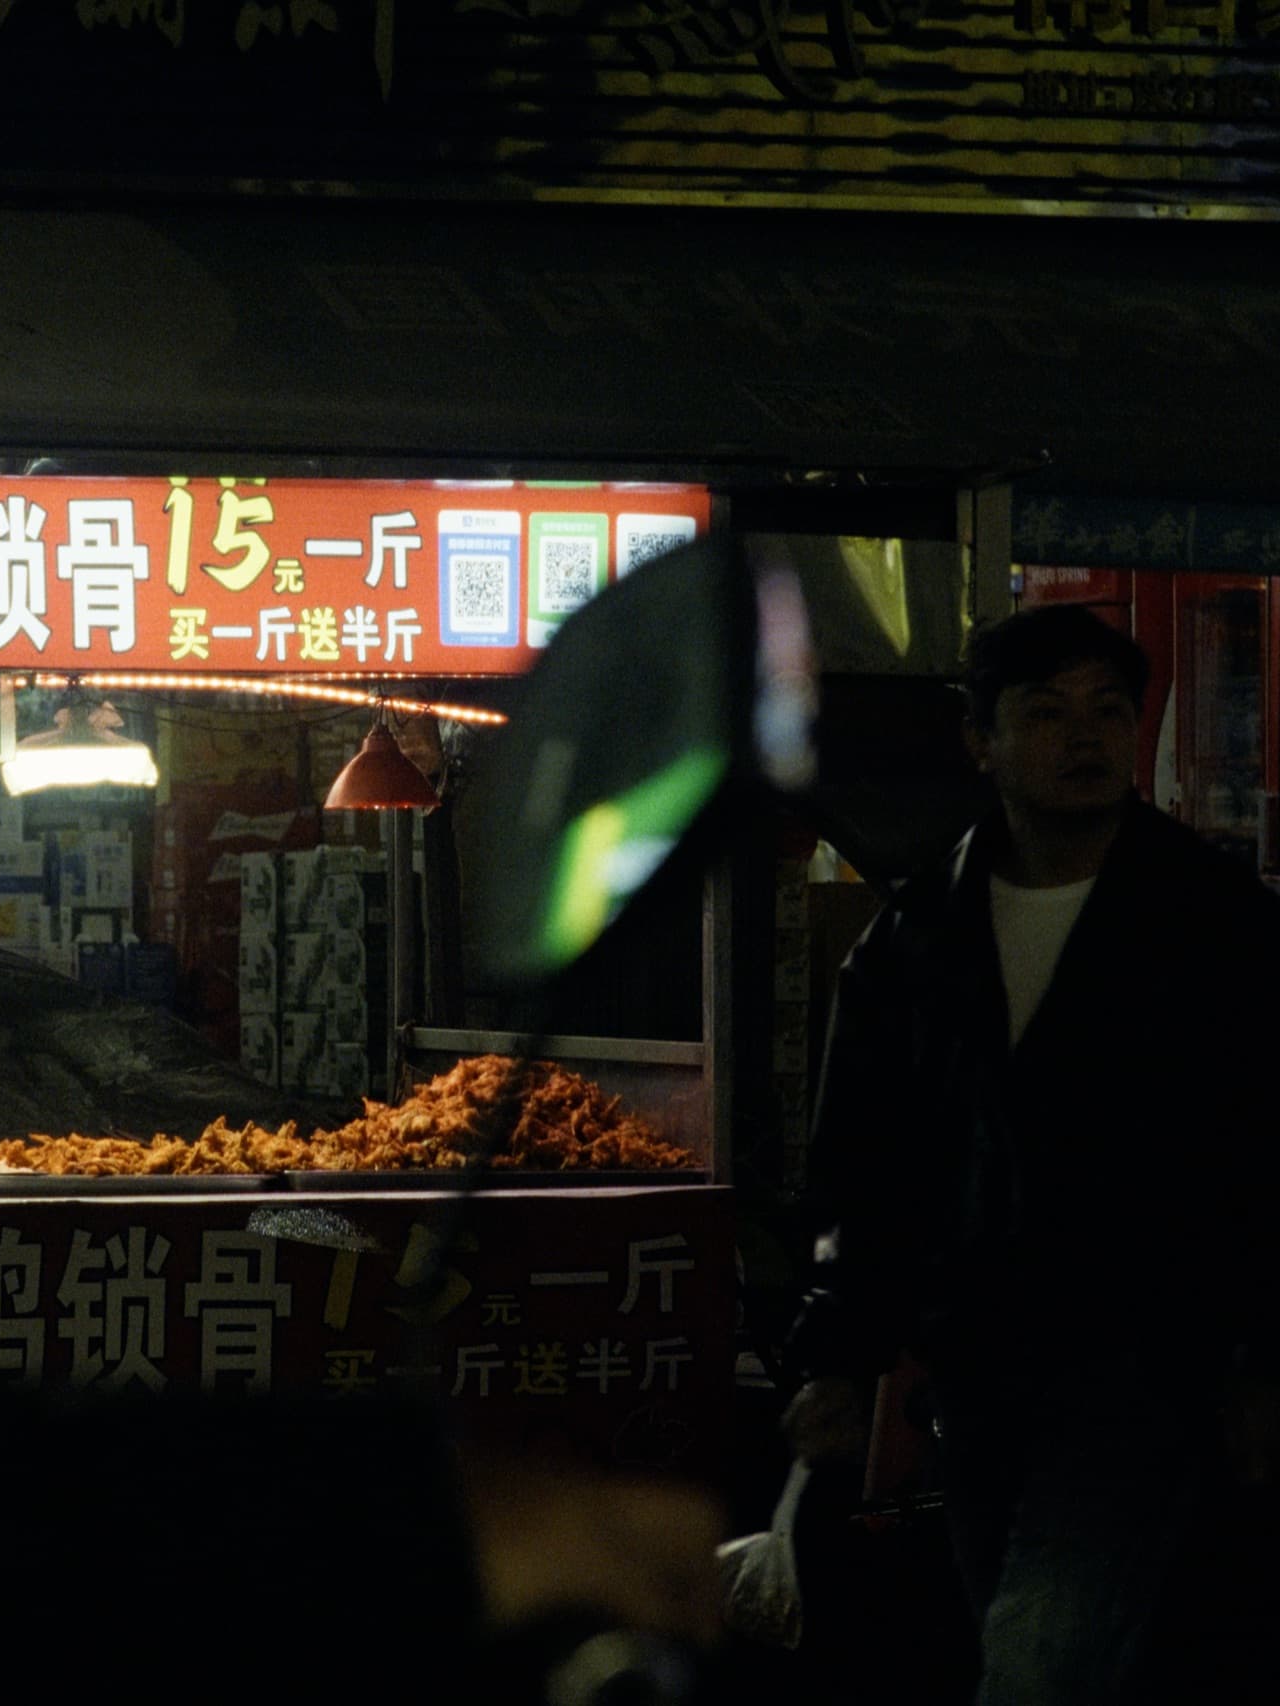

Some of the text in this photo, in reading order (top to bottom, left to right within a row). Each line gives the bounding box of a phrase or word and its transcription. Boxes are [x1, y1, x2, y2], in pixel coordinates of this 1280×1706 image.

[169, 606, 422, 662] 买一斤送半斤
